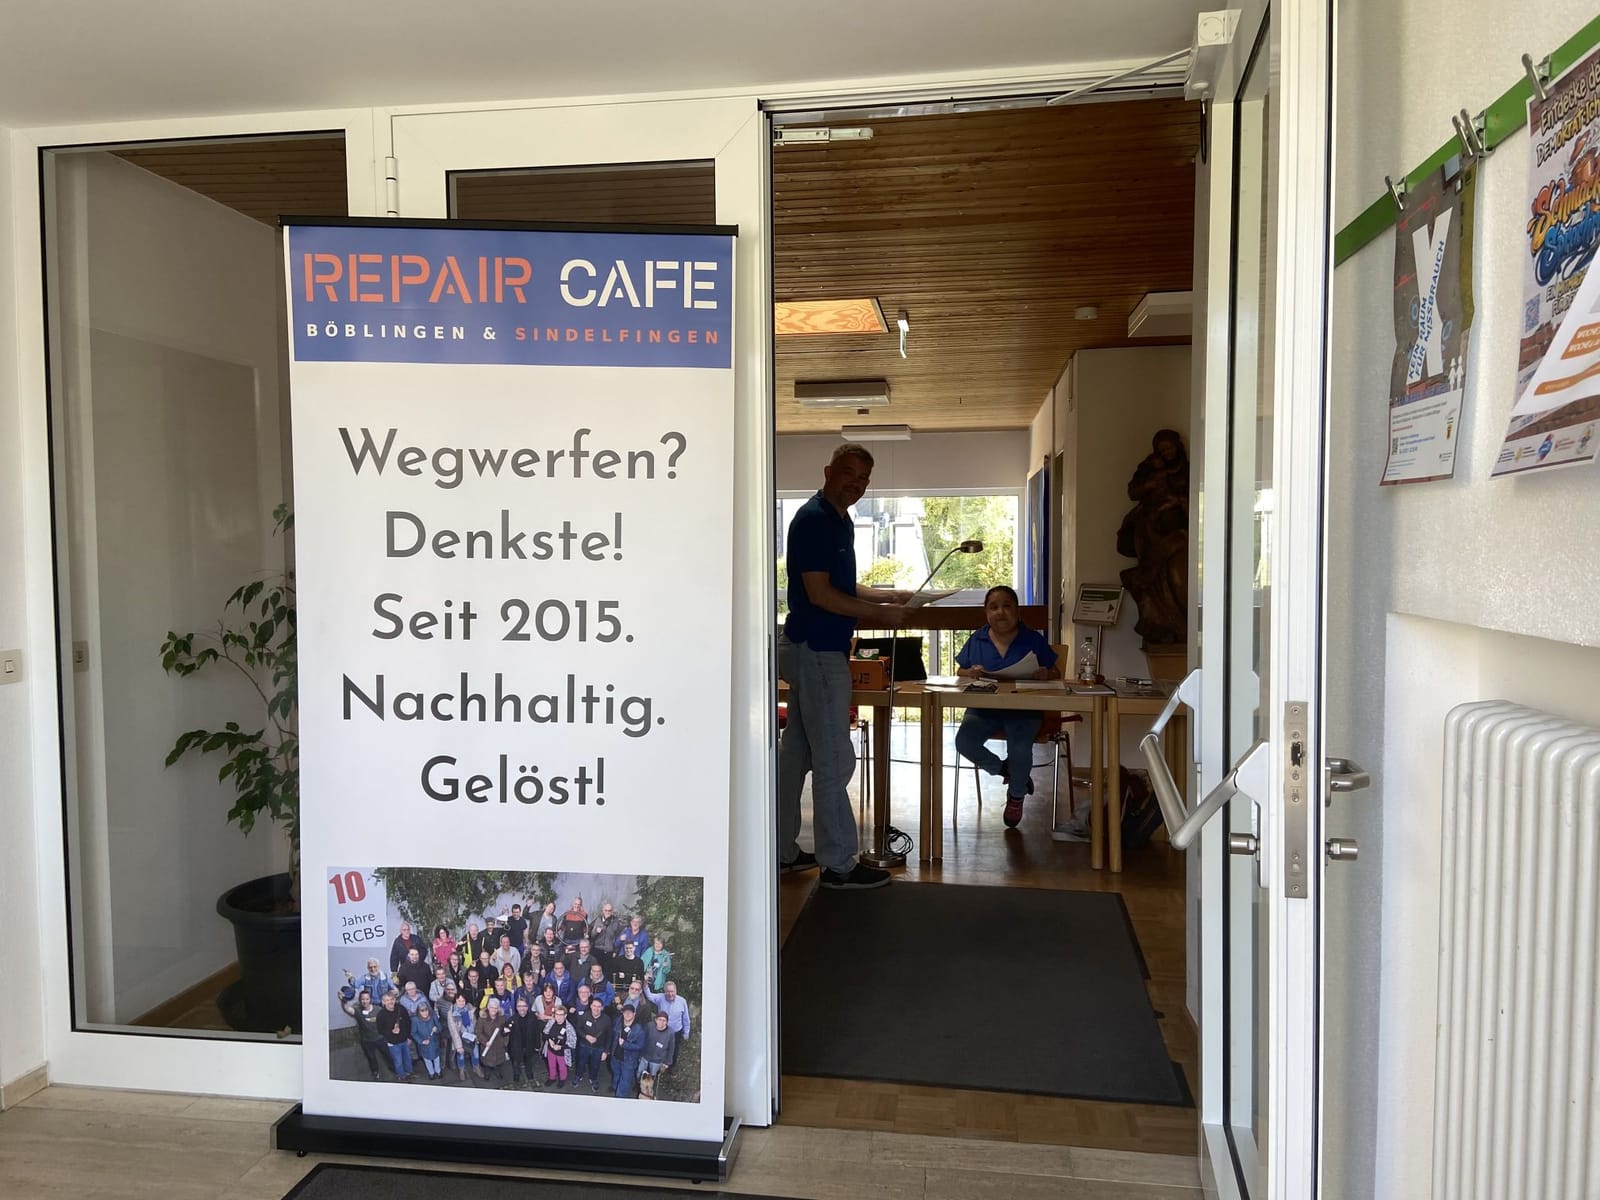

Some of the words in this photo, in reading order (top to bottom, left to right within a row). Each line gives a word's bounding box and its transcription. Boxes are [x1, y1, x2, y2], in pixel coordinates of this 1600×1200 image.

[304, 253, 532, 304] REPAIR
[559, 258, 718, 309] CAFE
[1424, 240, 1444, 342] MISSBRAUCH
[306, 321, 465, 340] BÖBLINGEN
[483, 327, 496, 341] &
[514, 327, 719, 345] SINDELFINGEN
[1408, 344, 1420, 379] KEIN
[1419, 297, 1428, 340] RAUM
[338, 427, 688, 490] Wegwerfen?
[386, 510, 623, 561] Denkste!
[371, 593, 477, 640] Seit
[500, 598, 634, 643] 2015.
[342, 672, 666, 738] Nachhaltig.
[421, 754, 606, 806] Gelöst!
[329, 871, 366, 904] 10
[342, 912, 376, 927] Jahre
[342, 925, 385, 945] RCBS
